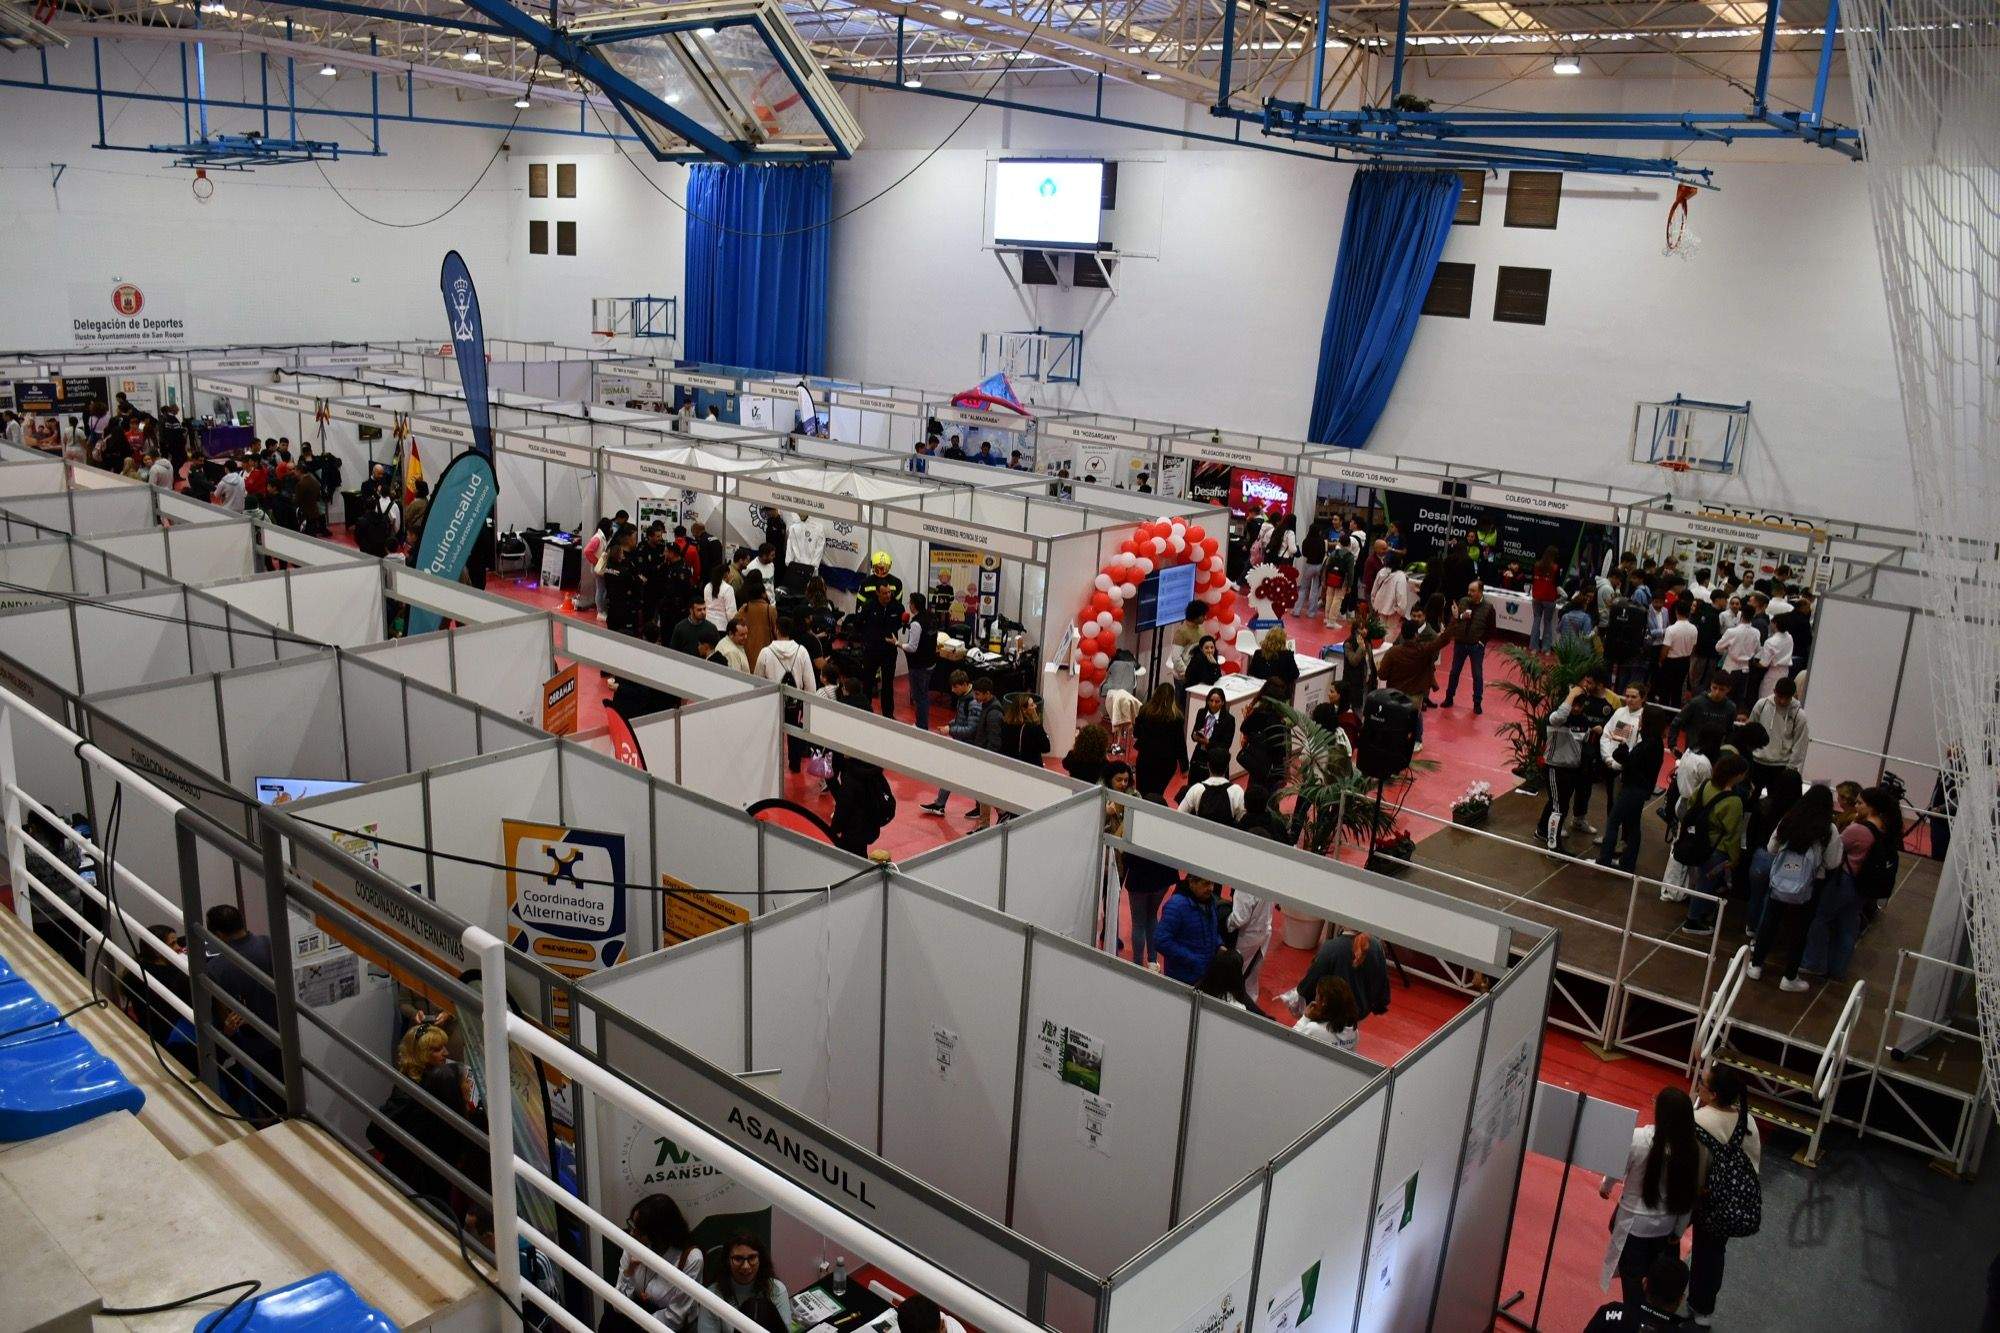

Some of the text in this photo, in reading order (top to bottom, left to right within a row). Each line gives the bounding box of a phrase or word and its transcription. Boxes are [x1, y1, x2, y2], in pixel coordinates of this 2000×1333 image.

[73, 318, 184, 332] Delegación de Deportes
[97, 332, 141, 341] Ayuntamiento
[165, 331, 184, 339] Roque
[1231, 452, 1252, 461] DEPORTES
[1341, 469, 1398, 484] COLEGIO "LOS PINOS"
[1194, 485, 1228, 498] Desafíos
[1242, 479, 1288, 501] Desafíos
[1505, 494, 1569, 510] COLEGIO "LOS PINOS"
[431, 473, 482, 573] quironsalud
[1419, 508, 1478, 526] Desarrollo
[1506, 513, 1535, 523] TRANSPORTE
[1413, 522, 1467, 537] profesion
[1503, 540, 1522, 548] NTRO
[1504, 547, 1536, 558] TORIZADO
[523, 889, 604, 910] Coordinadora
[706, 898, 736, 917] NOSOTROS
[355, 880, 465, 962] COORDINADORA ALTERNATIVAS
[523, 904, 605, 926] Alternativas
[727, 1105, 876, 1210] ASANSULL
[644, 1165, 722, 1185] ASANSUL
[1640, 1304, 1670, 1321] HELLY HANSEN
